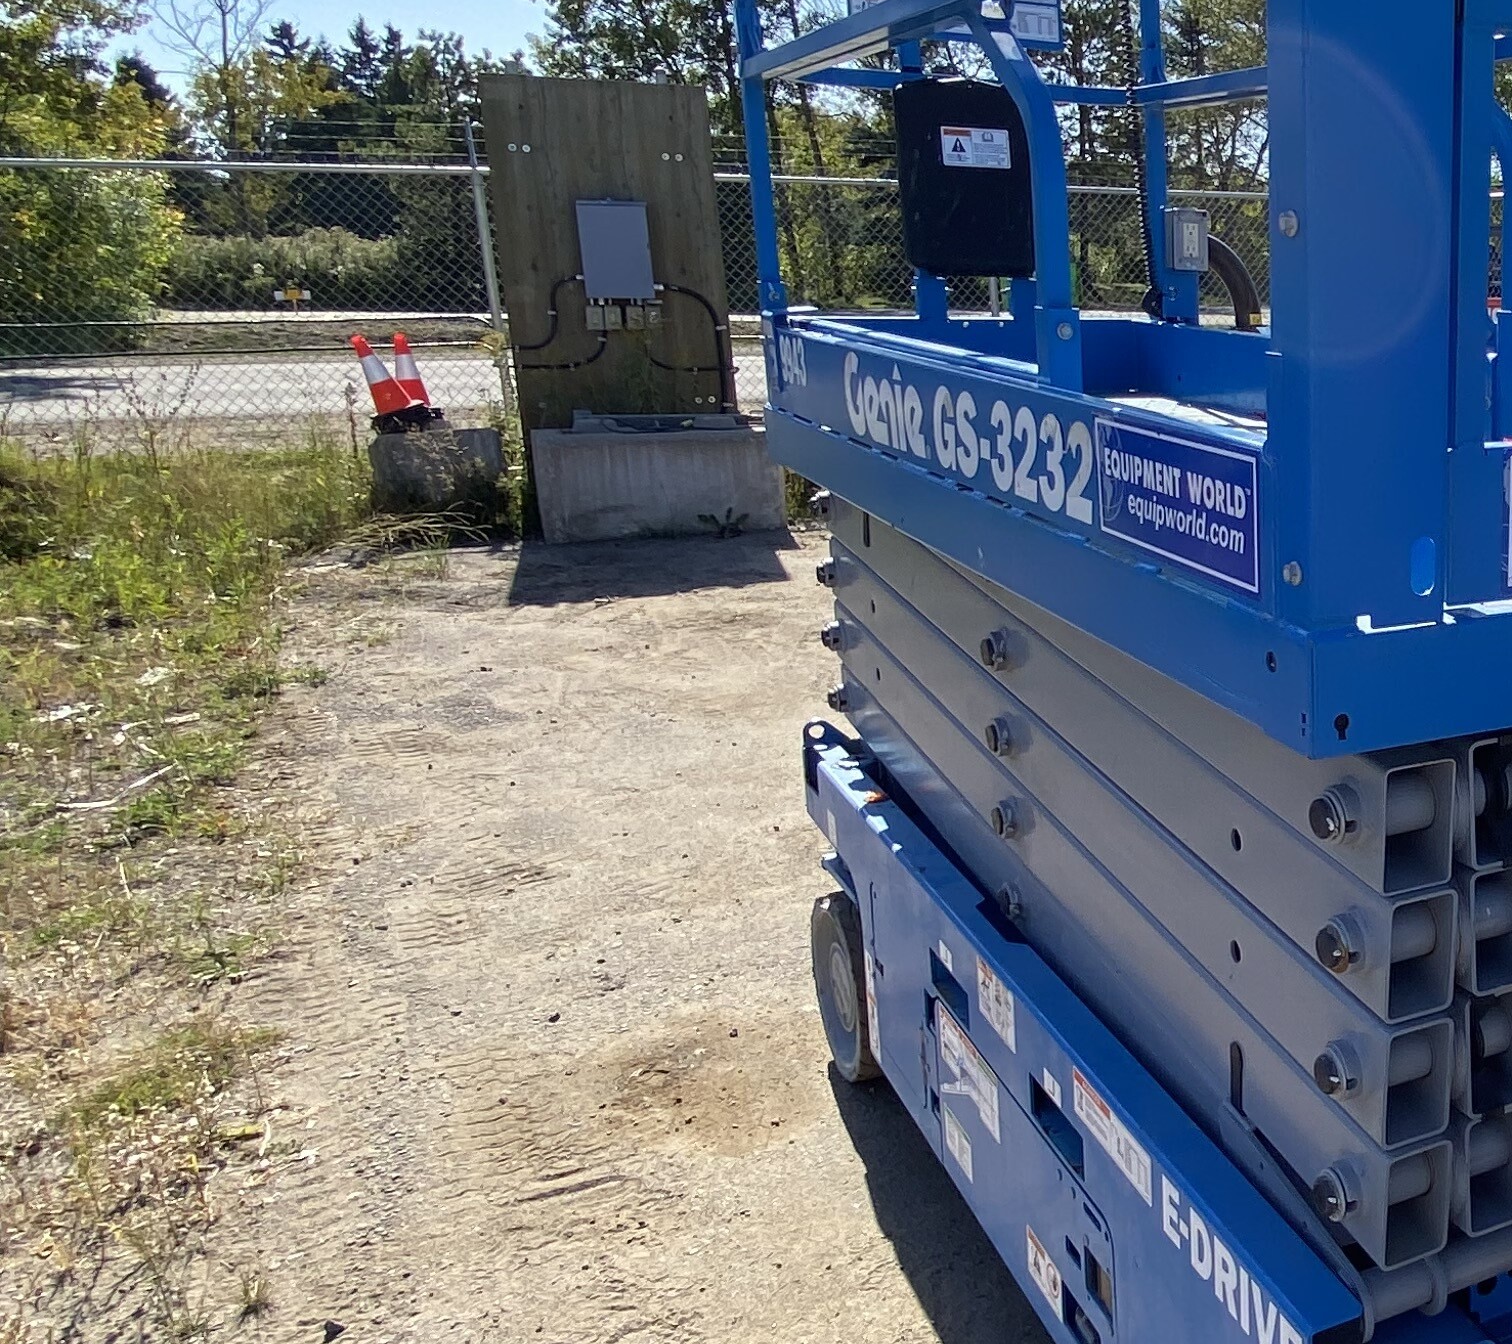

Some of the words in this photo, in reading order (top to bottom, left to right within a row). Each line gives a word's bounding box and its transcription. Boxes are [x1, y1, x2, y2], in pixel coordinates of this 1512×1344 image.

[844, 351, 926, 459] Genie
[933, 385, 1093, 525] GS-3232
[1103, 447, 1181, 498] EQUIPMENT
[1186, 471, 1247, 519] WORLD
[1127, 494, 1245, 554] equipworld.com
